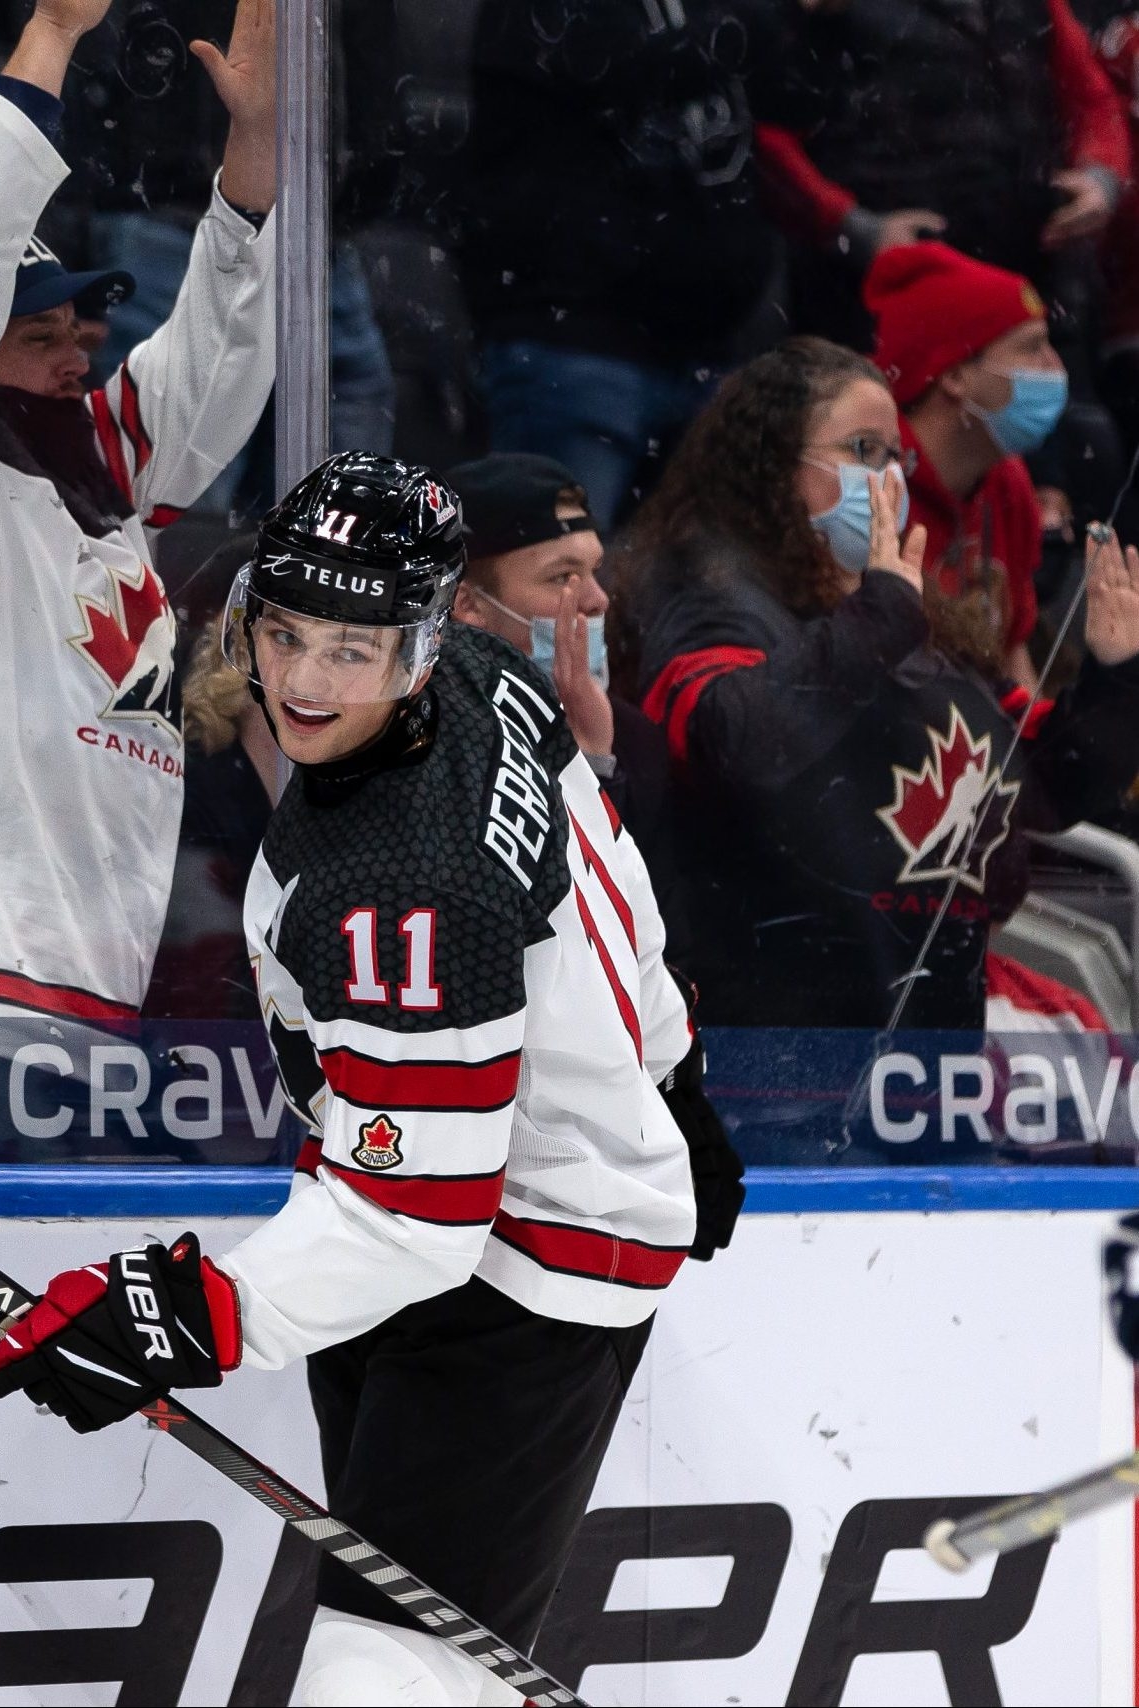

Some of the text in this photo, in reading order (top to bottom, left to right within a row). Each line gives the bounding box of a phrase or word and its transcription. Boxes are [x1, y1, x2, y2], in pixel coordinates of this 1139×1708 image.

[316, 510, 358, 544] 11
[303, 563, 385, 597] TELUS
[341, 907, 443, 1011] 11
[358, 1149, 397, 1166] CANADA
